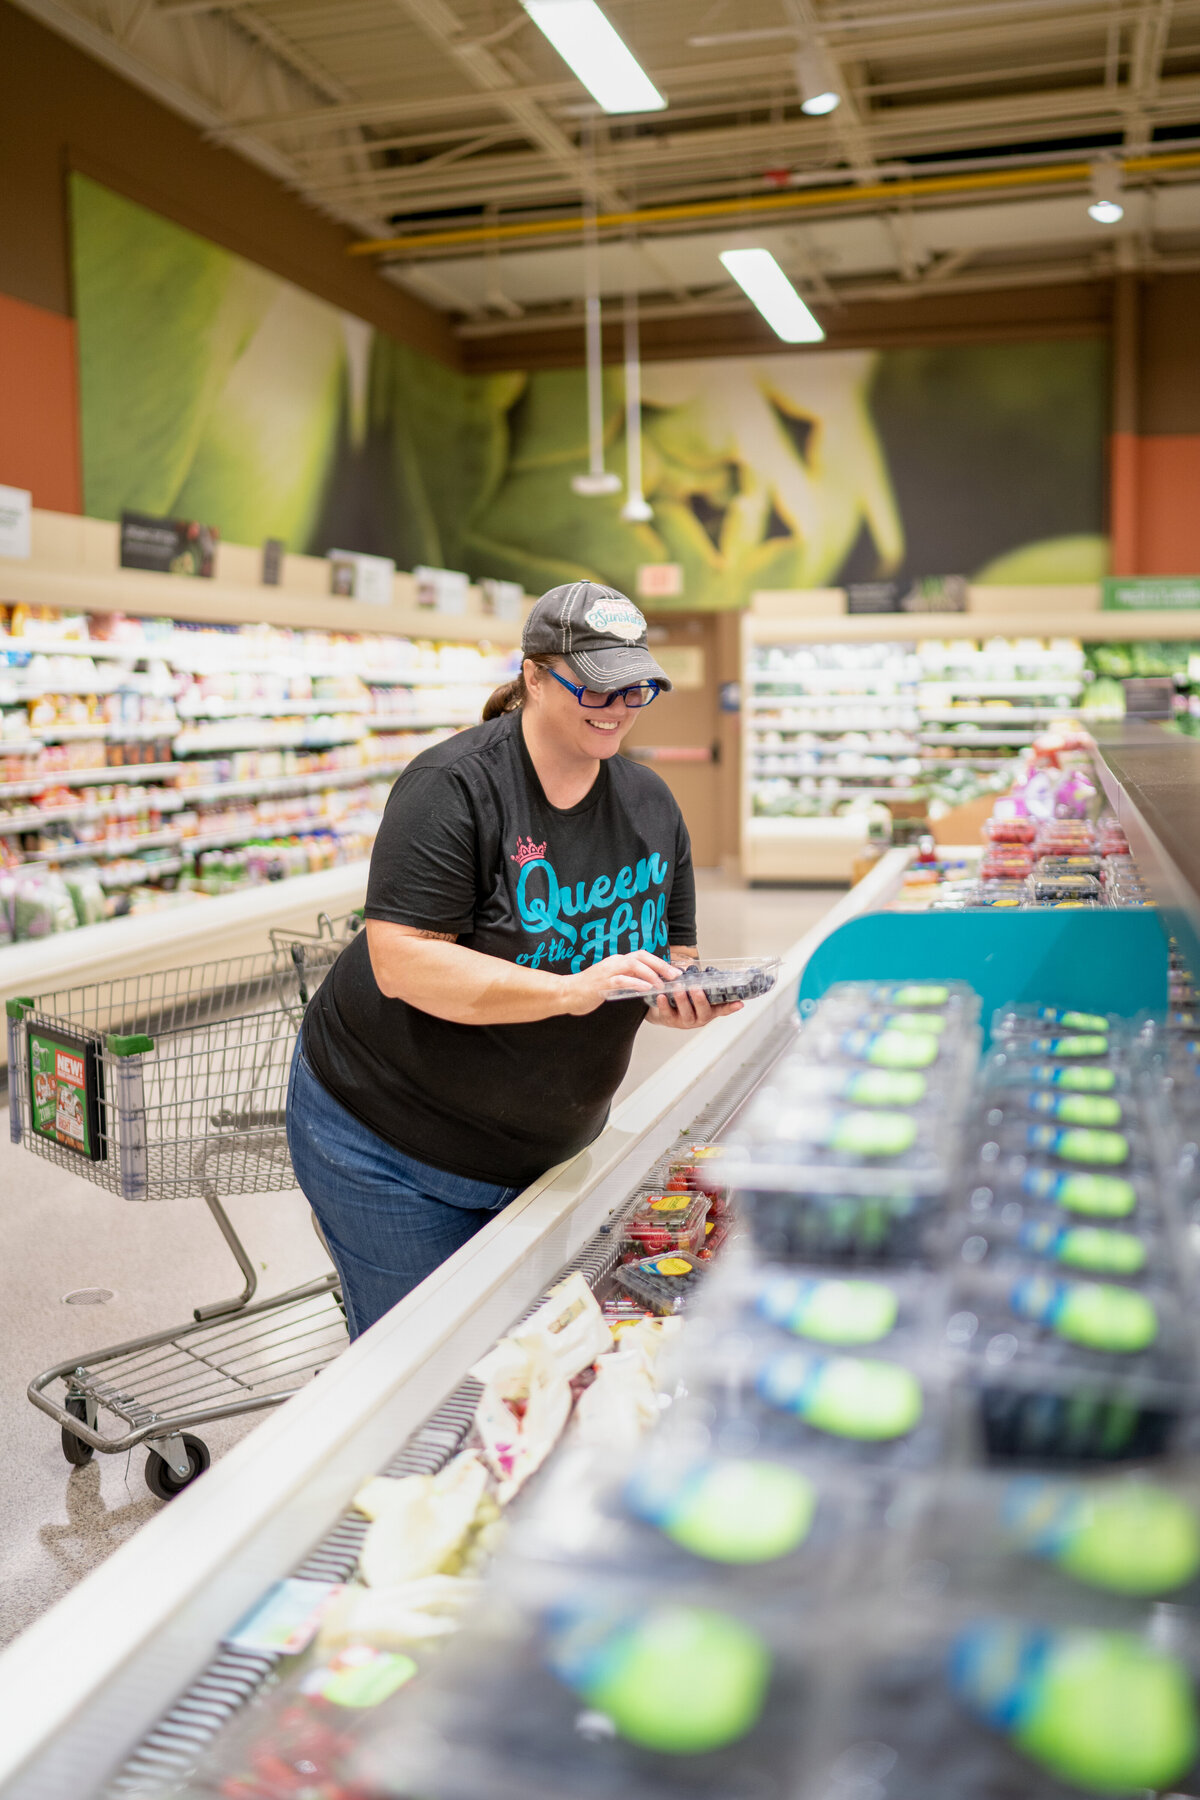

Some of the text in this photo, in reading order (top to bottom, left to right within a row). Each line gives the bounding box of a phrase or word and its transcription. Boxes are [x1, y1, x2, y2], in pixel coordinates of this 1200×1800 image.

[516, 851, 668, 946] Queen
[516, 892, 668, 975] of the Hill
[57, 1053, 83, 1079] NEW!
